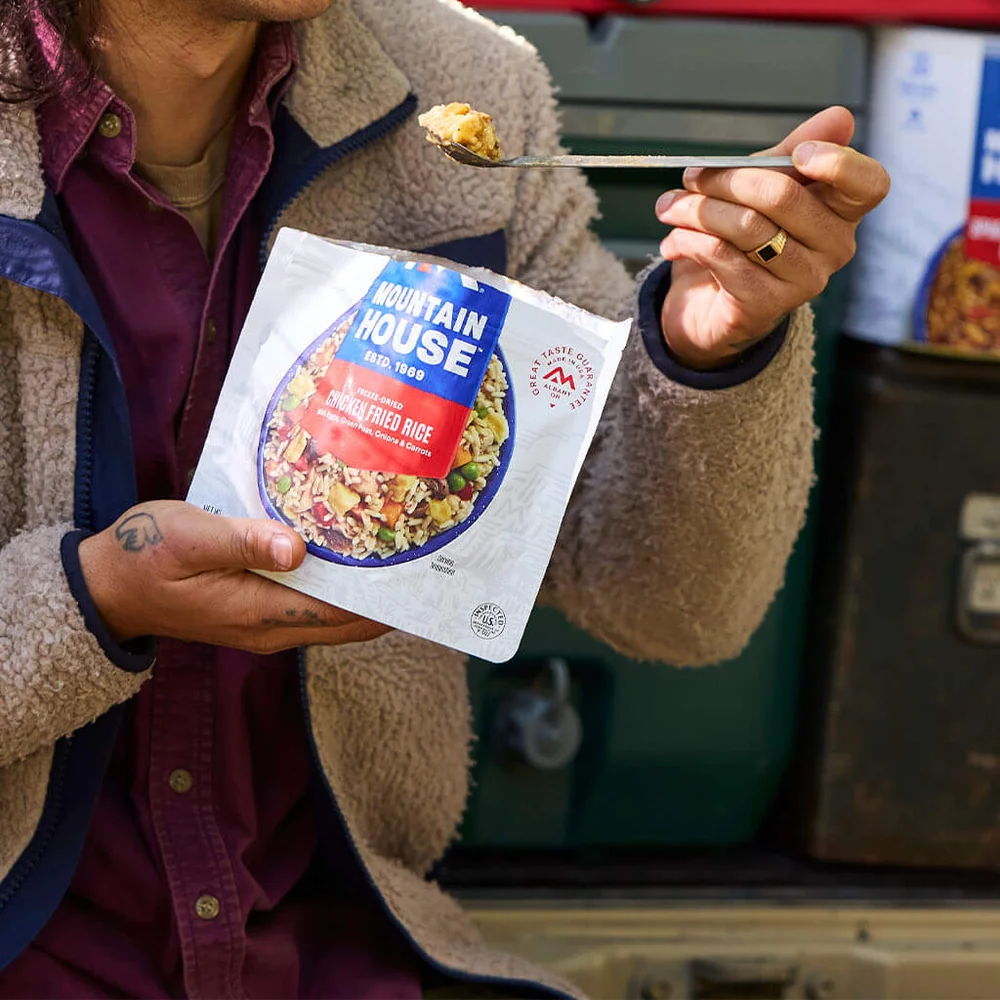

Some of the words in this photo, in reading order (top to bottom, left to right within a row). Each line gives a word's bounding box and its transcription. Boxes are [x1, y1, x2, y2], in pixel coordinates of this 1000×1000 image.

[371, 280, 488, 341] MOUNTAIN
[363, 350, 391, 370] ESTD.
[393, 360, 425, 381] 1969
[529, 358, 542, 396] GREAT
[541, 346, 573, 359] TASTE
[569, 352, 594, 411] GUARANTEE
[543, 383, 571, 397] ALBANY
[325, 389, 368, 421] CHICKEN
[366, 404, 402, 432] FRIED
[401, 417, 434, 445] RICE
[374, 429, 399, 446] Onions
[399, 439, 405, 448] &
[405, 441, 432, 458] Carrots
[474, 604, 504, 626] INSPECTED
